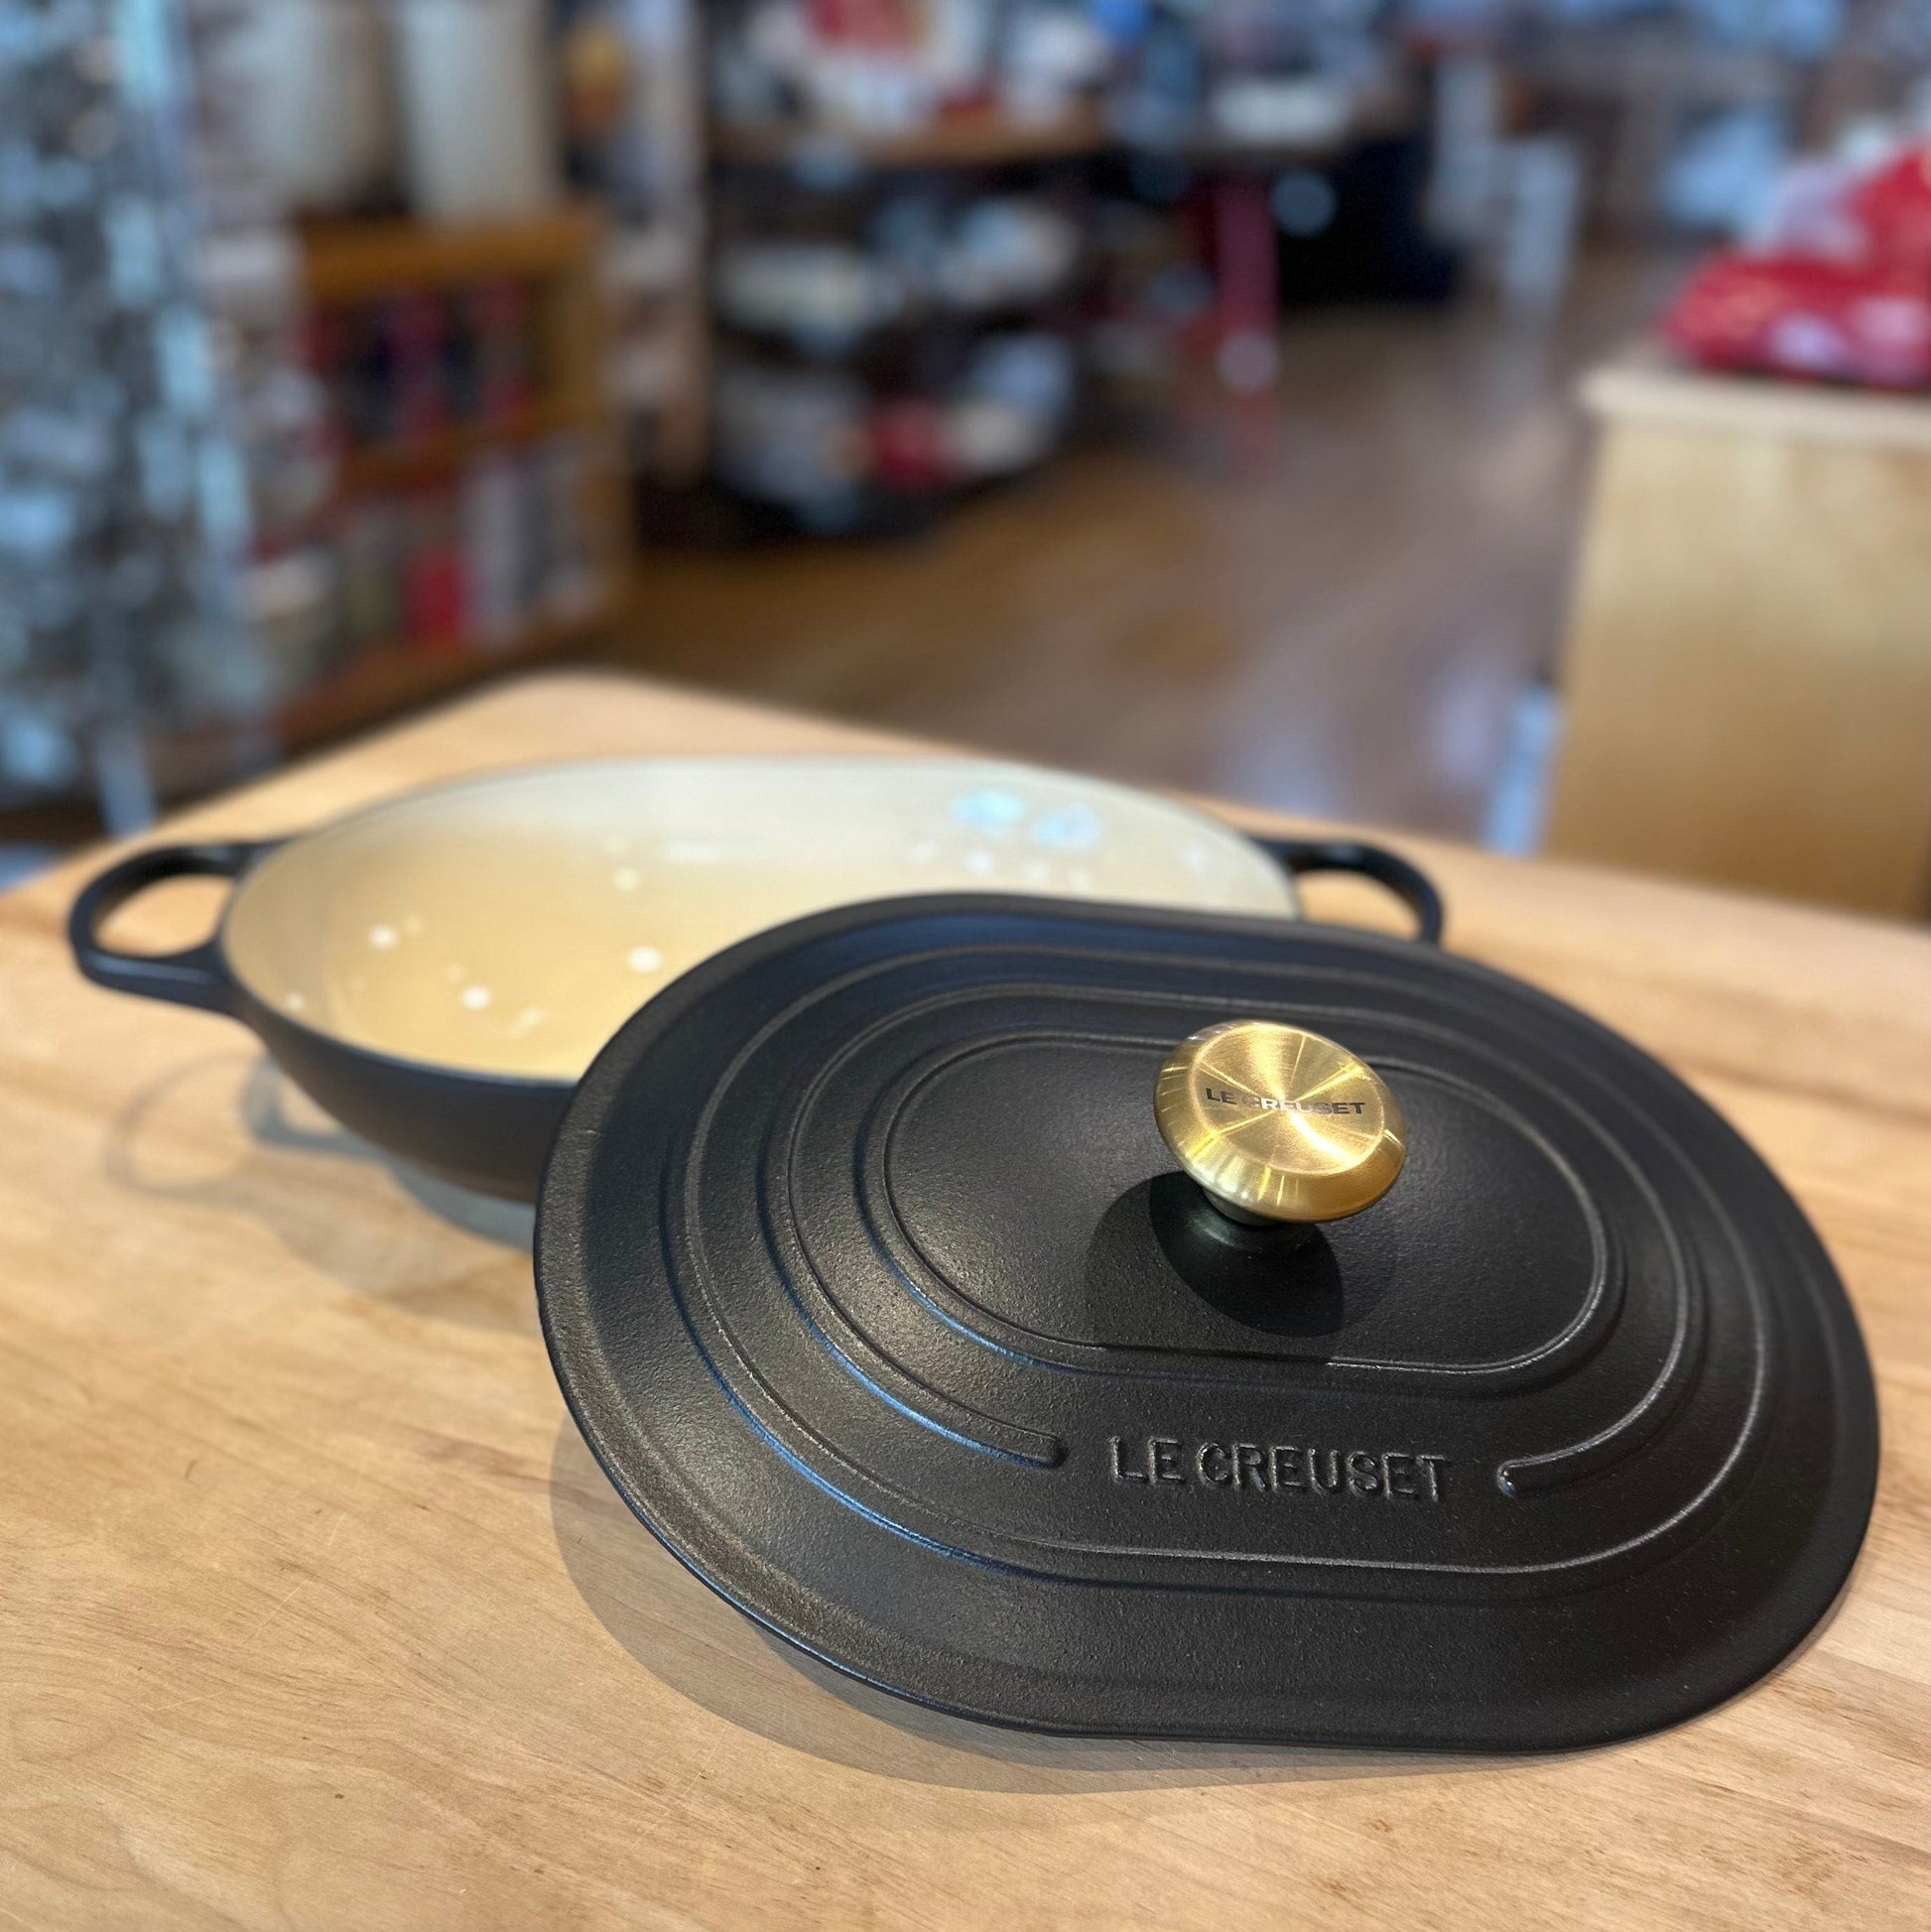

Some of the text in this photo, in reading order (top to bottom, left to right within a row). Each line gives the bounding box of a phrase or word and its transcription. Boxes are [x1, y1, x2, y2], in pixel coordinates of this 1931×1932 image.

[1206, 1088, 1365, 1115] LE CREUSET
[1108, 1436, 1449, 1501] LE CREUSET
